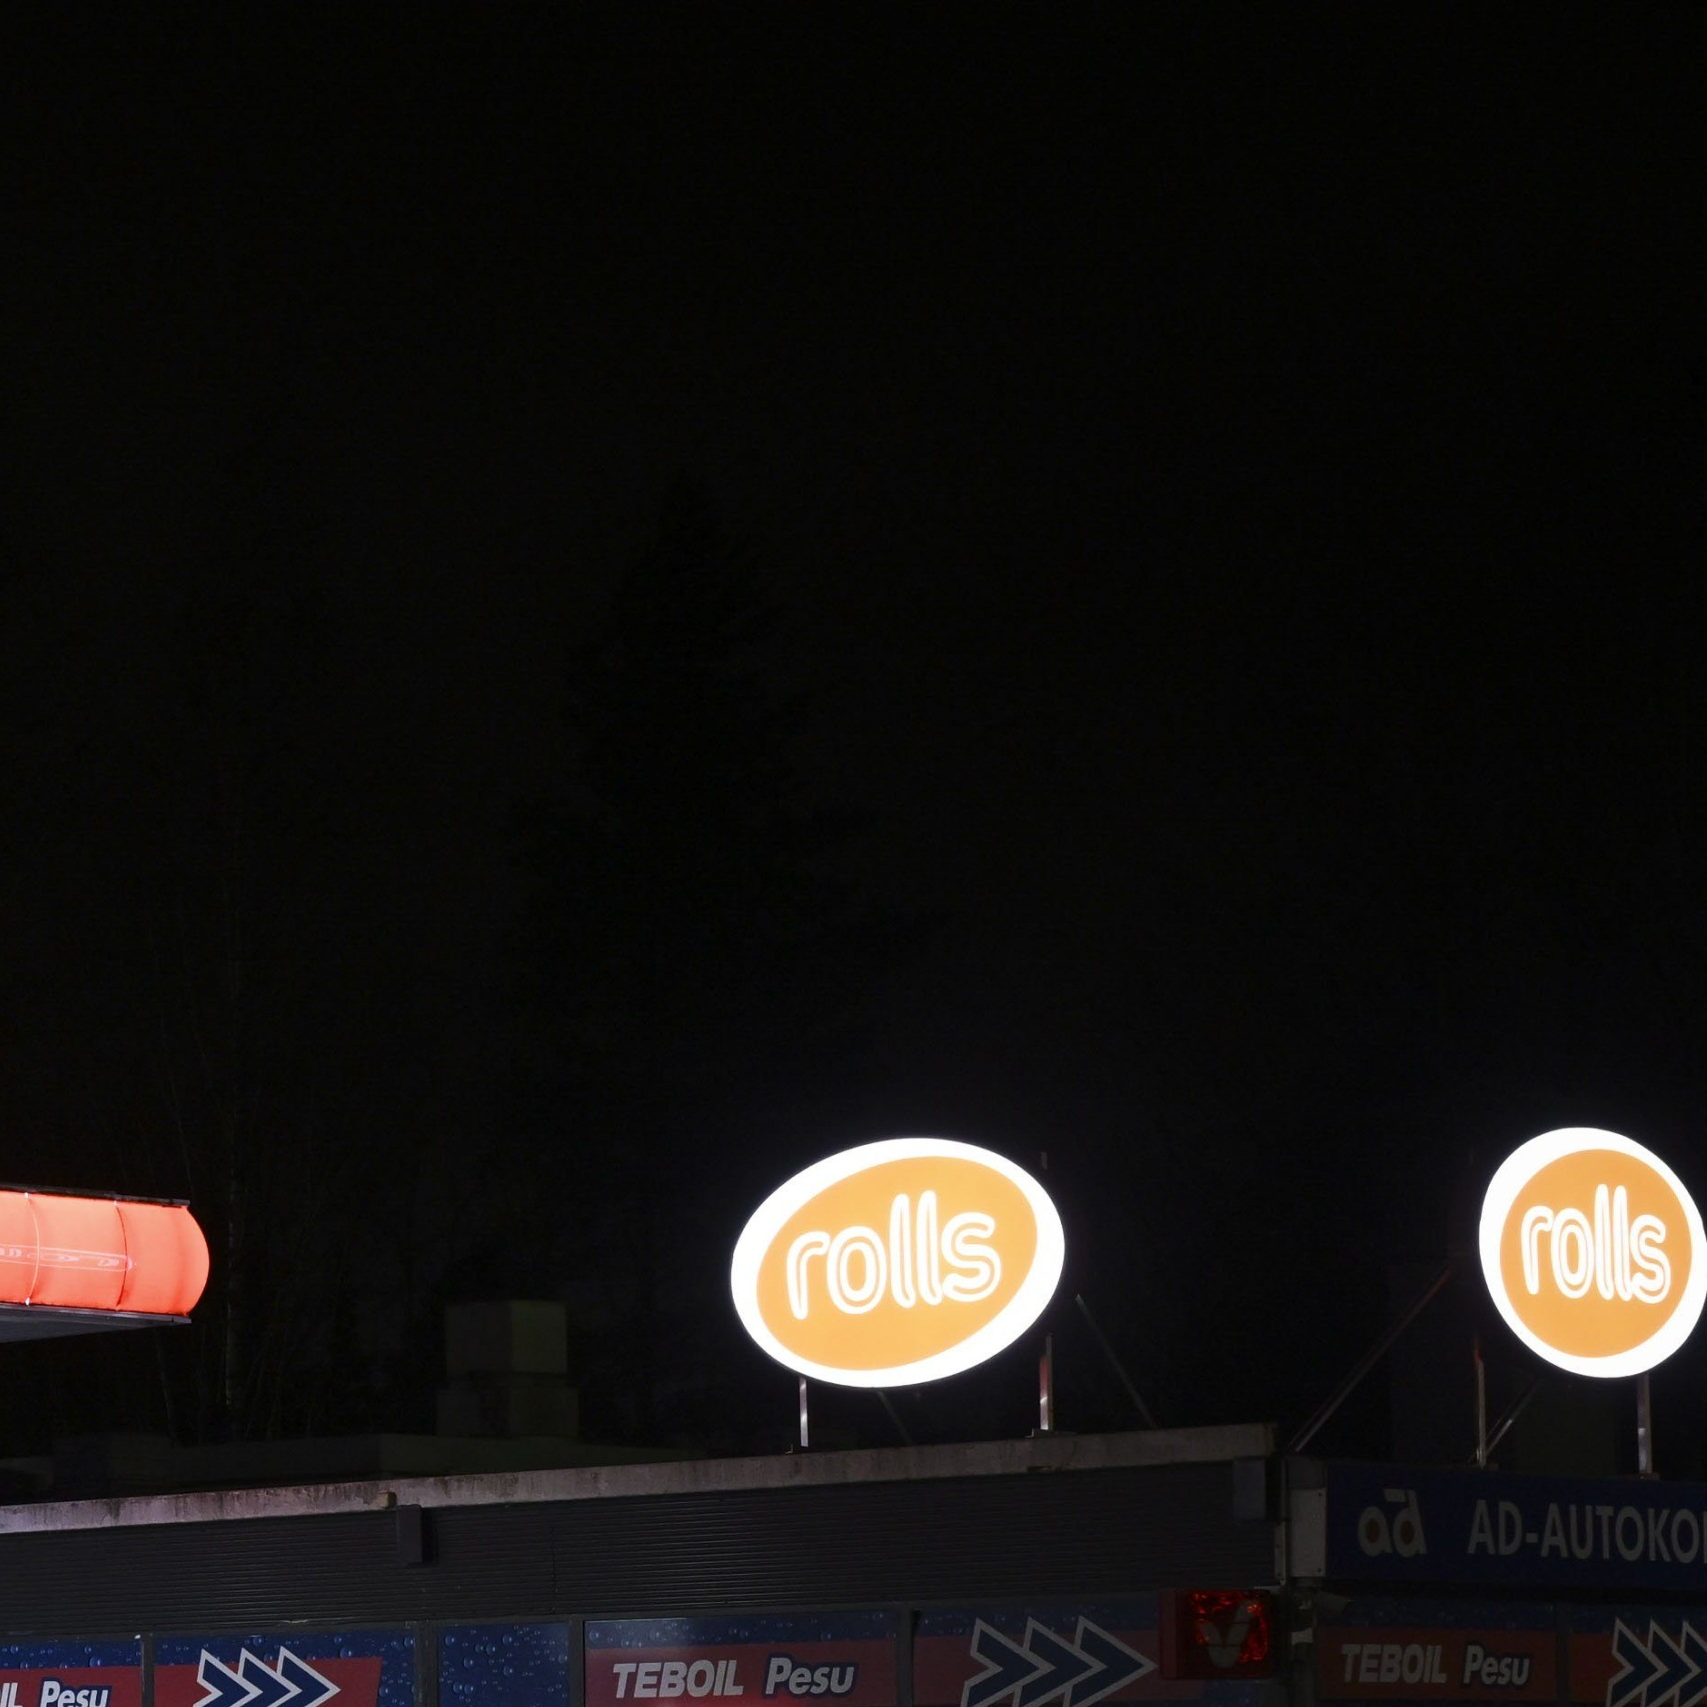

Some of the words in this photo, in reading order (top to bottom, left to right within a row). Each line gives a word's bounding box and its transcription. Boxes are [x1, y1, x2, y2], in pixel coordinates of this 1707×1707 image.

[786, 1190, 1001, 1319] rolls
[1520, 1184, 1672, 1305] rolls
[1467, 1499, 1707, 1565] AD-AUTOKO
[613, 1659, 744, 1698] TEBOIL
[765, 1657, 855, 1695] Pesu
[1340, 1643, 1448, 1684] TEBOIL
[1463, 1645, 1531, 1686] Pesu
